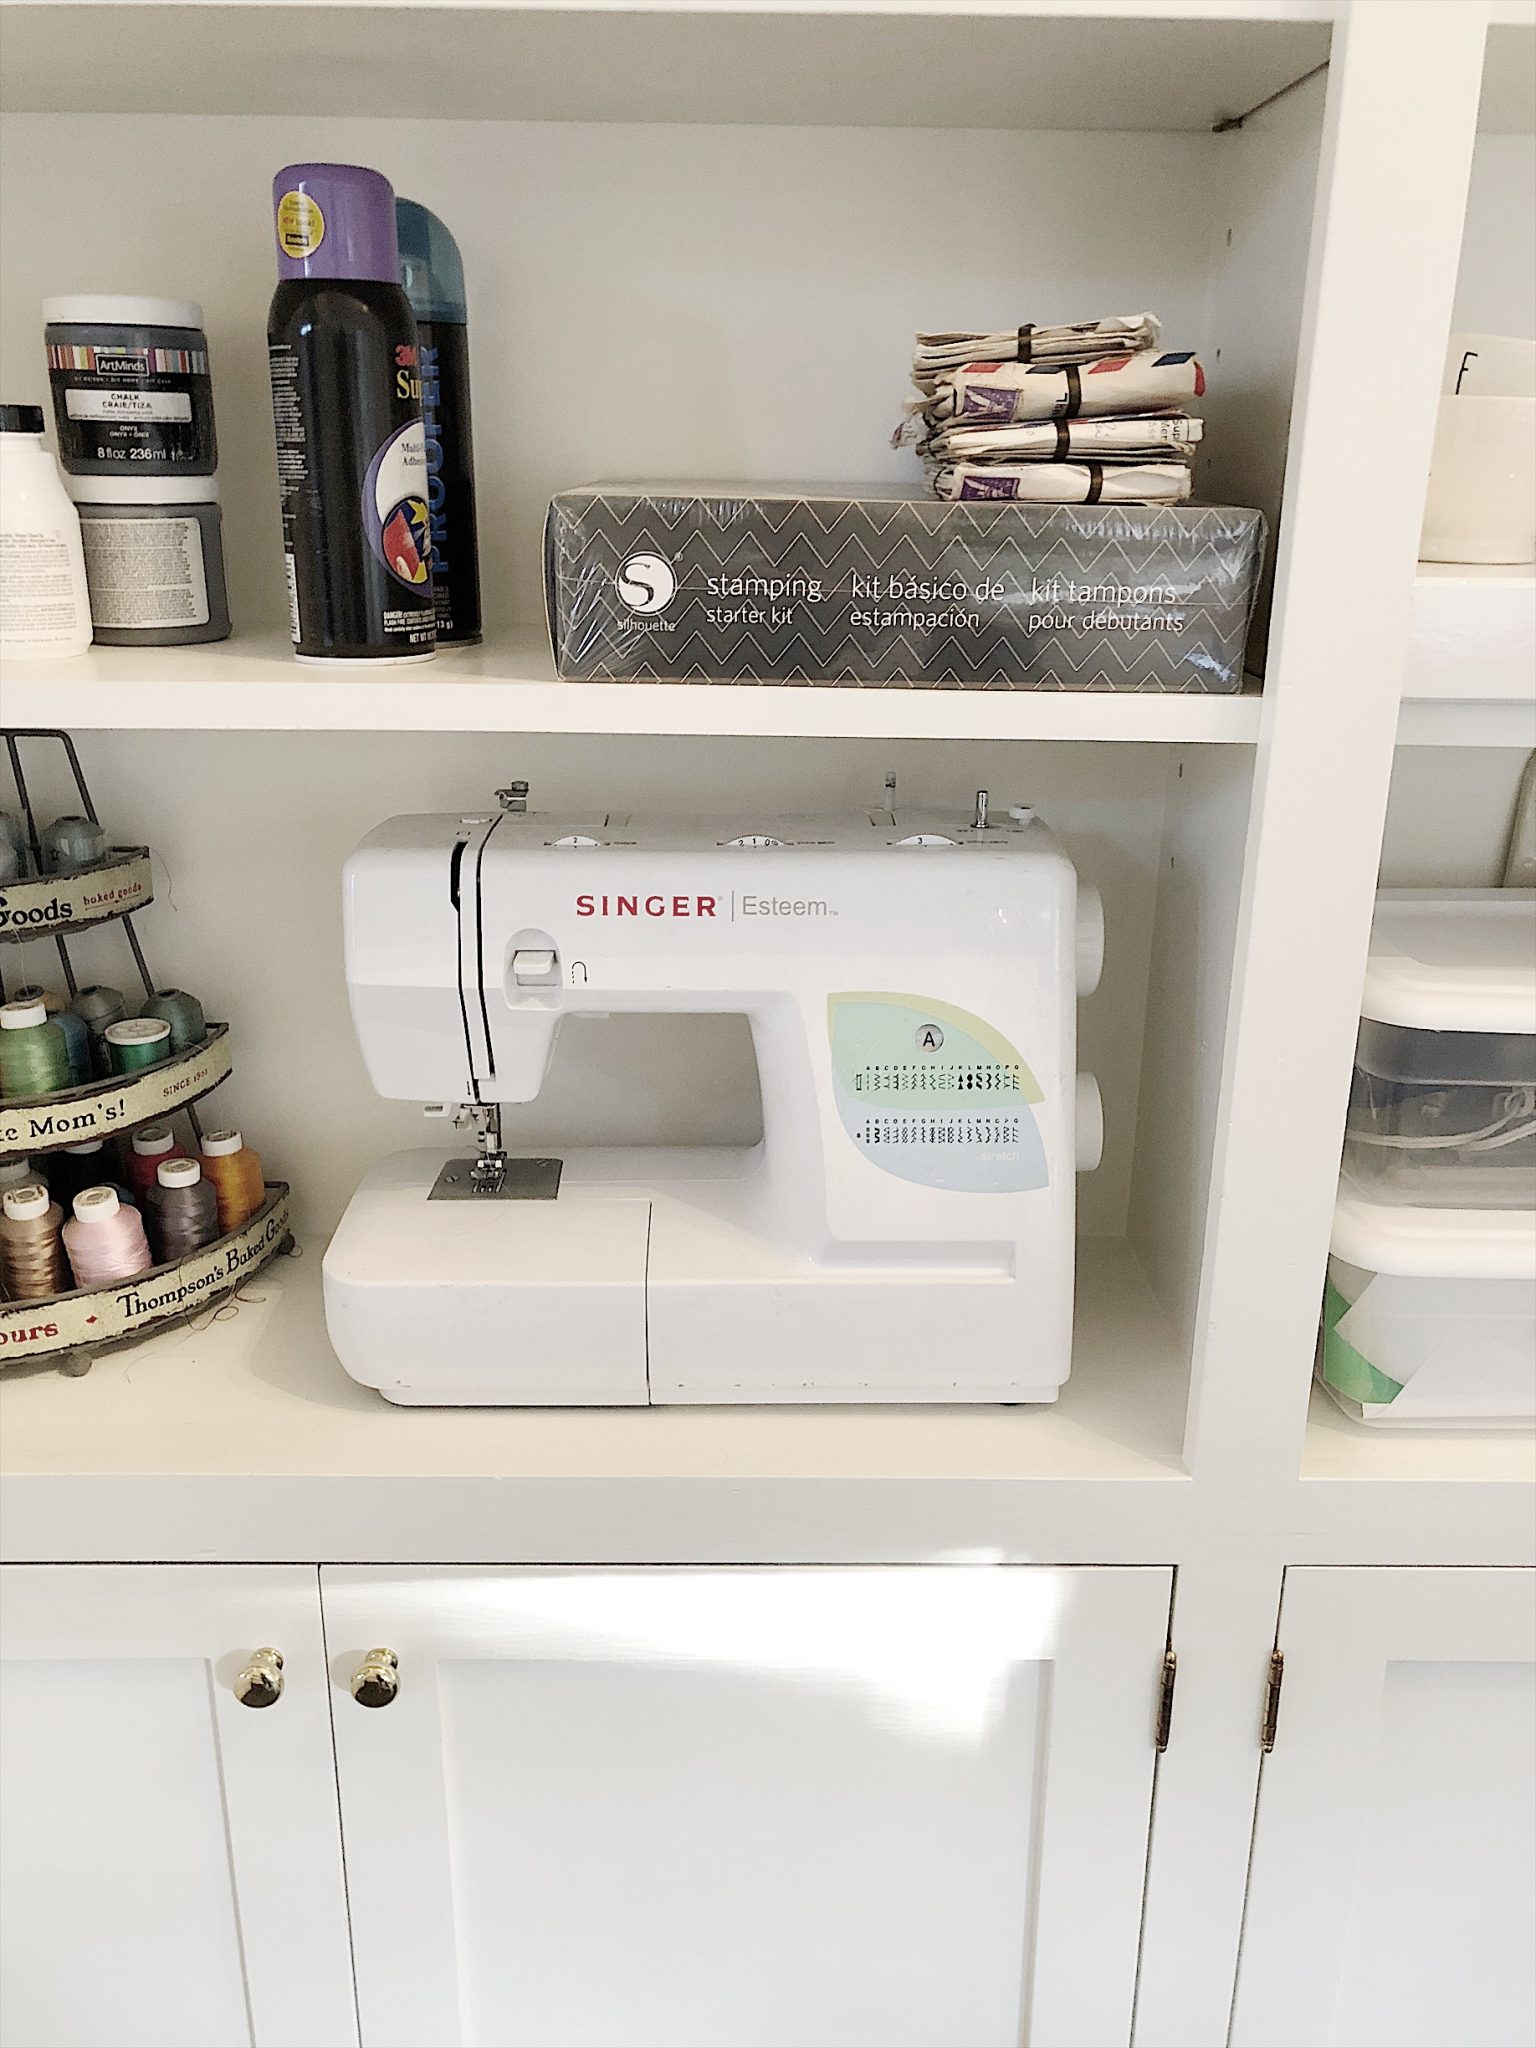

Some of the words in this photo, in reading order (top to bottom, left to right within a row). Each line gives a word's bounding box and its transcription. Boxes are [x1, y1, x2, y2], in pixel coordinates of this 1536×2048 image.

[100, 360, 145, 371] ArtMinds
[1455, 352, 1478, 395] F
[111, 393, 140, 401] CHALK
[102, 401, 152, 410] CRAIE/TIZA
[97, 446, 105, 459] 8
[706, 573, 823, 602] stamping
[851, 574, 881, 599] kit
[888, 574, 968, 601] básico
[974, 576, 1006, 601] de
[1031, 577, 1061, 602] kit
[1068, 579, 1177, 607] tampons
[617, 619, 676, 633] silhouette
[706, 607, 766, 624] starter
[771, 605, 793, 624] kit
[849, 607, 980, 630] estampación
[1028, 613, 1075, 632] pour
[1082, 609, 1185, 633] débutants
[738, 839, 745, 847] 2
[917, 837, 923, 845] 3
[576, 895, 717, 917] SINGER
[742, 895, 827, 916] Esteem
[922, 1030, 936, 1048] A
[163, 1077, 191, 1097] SINCE
[0, 1128, 19, 1141] e
[29, 1098, 125, 1138] Mom's!
[981, 1150, 1020, 1162] stretch
[116, 1264, 224, 1318] Thompson's
[225, 1236, 265, 1276] Baked
